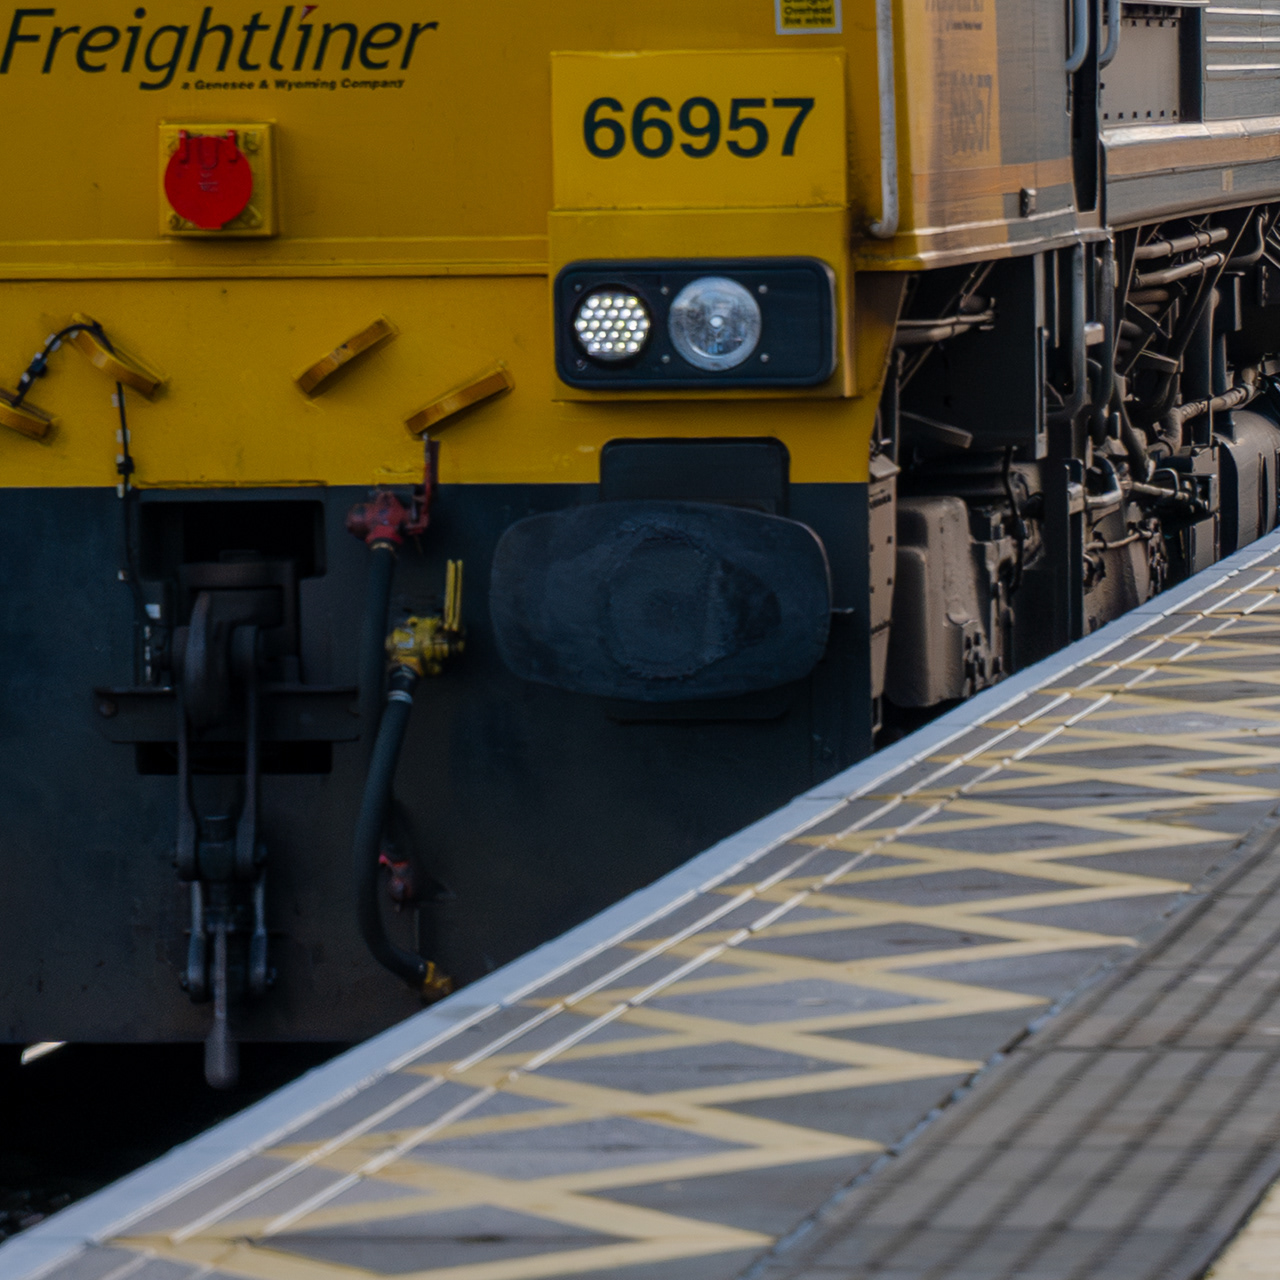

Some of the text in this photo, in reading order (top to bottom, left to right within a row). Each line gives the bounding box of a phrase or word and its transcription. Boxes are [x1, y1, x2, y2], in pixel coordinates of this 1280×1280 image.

[194, 79, 255, 90] Genesee
[258, 79, 269, 89] &
[274, 78, 337, 91] Wyoming
[340, 77, 405, 90] Company
[583, 96, 816, 159] 66957
